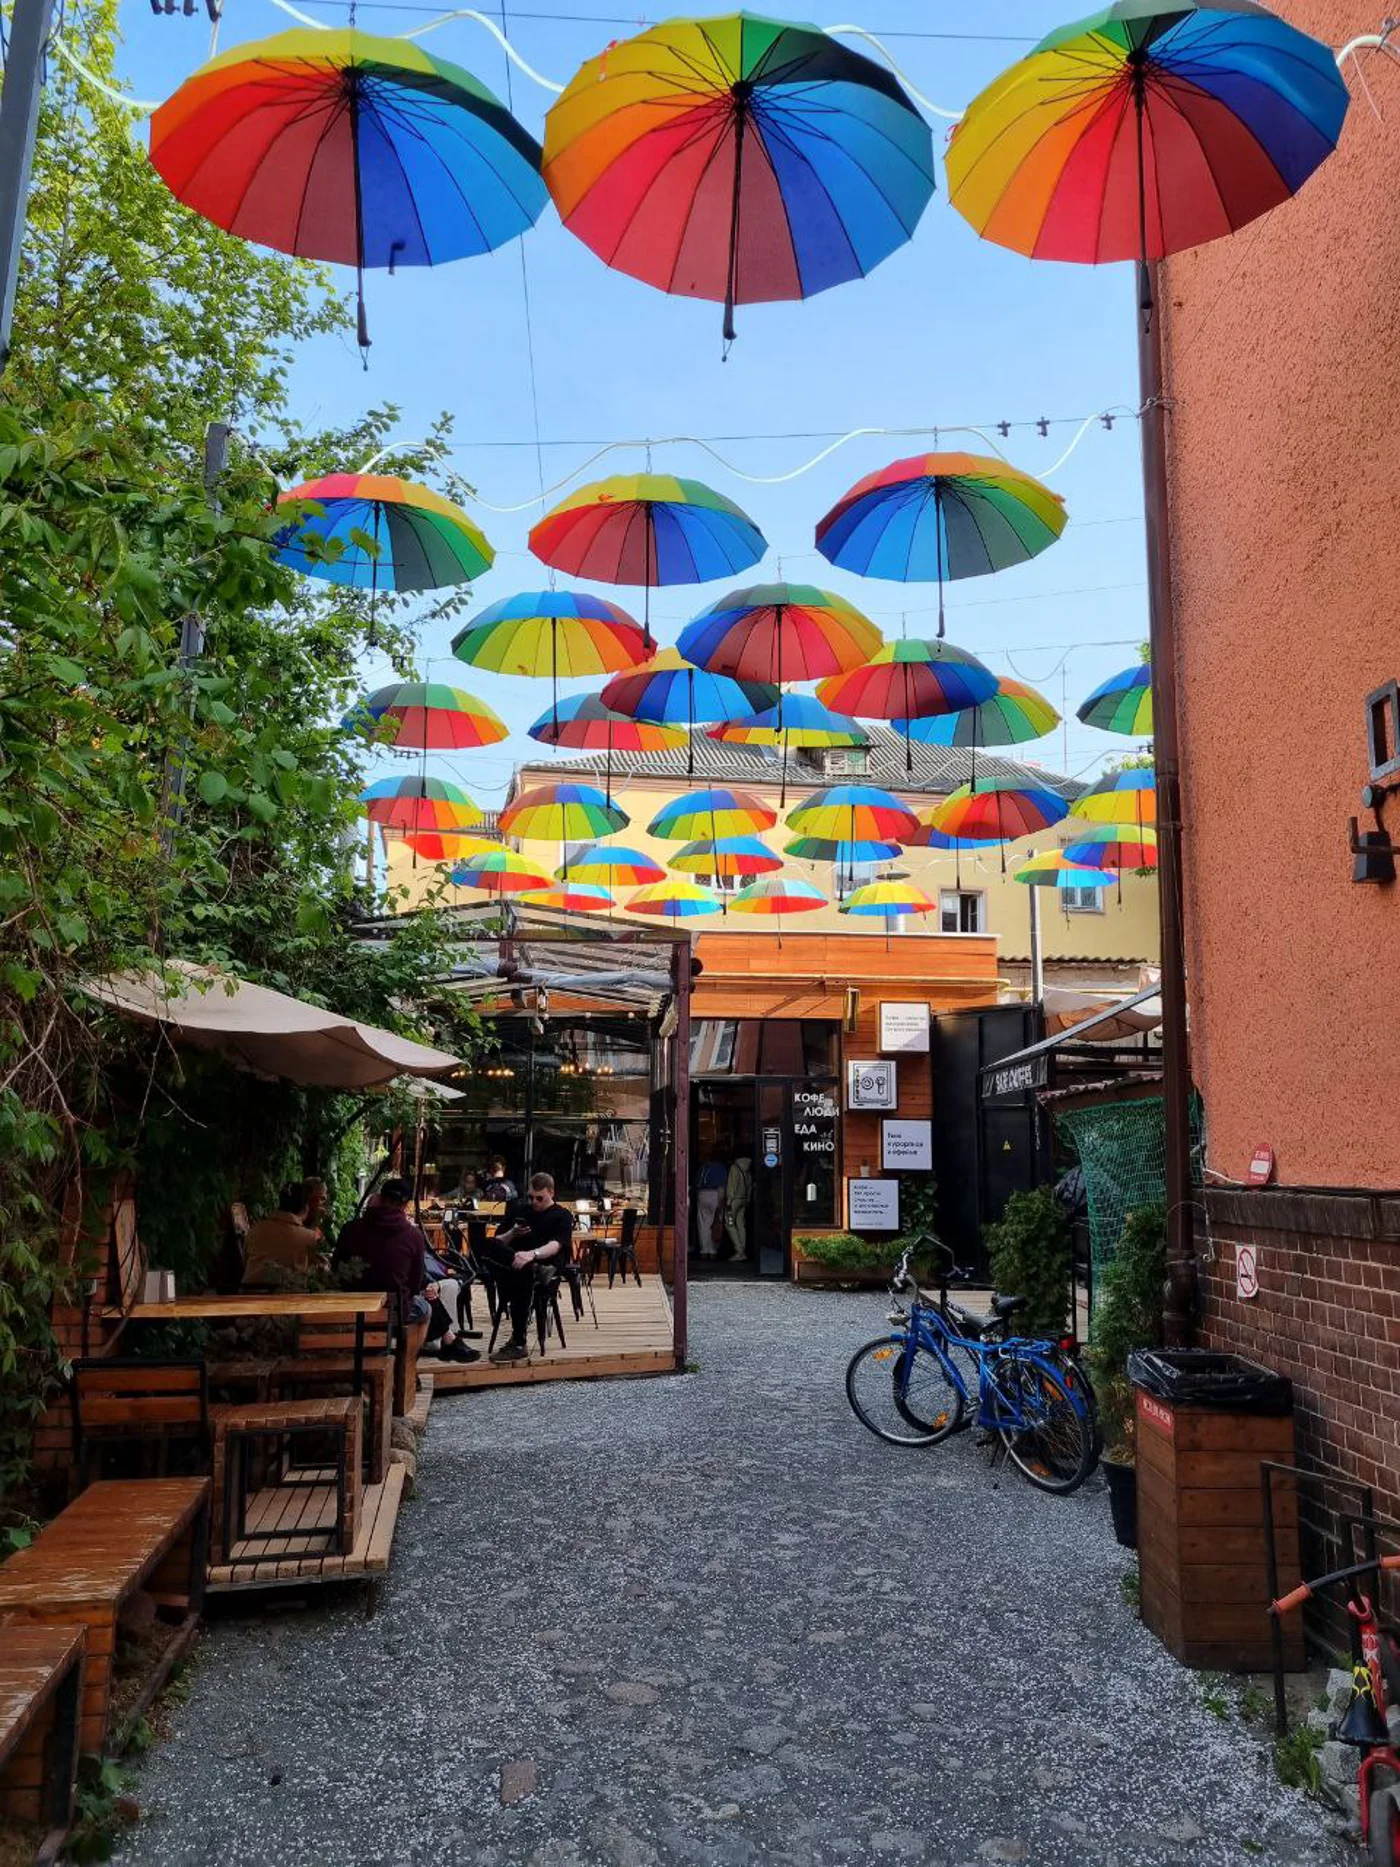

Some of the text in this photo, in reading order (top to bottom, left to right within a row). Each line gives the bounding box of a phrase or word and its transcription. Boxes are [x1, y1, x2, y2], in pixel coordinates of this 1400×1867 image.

[794, 1093, 825, 1103] КОФЕ
[804, 1106, 839, 1117] ЛЮДИ
[794, 1124, 817, 1135] ЕДА
[803, 1141, 834, 1151] КИНО
